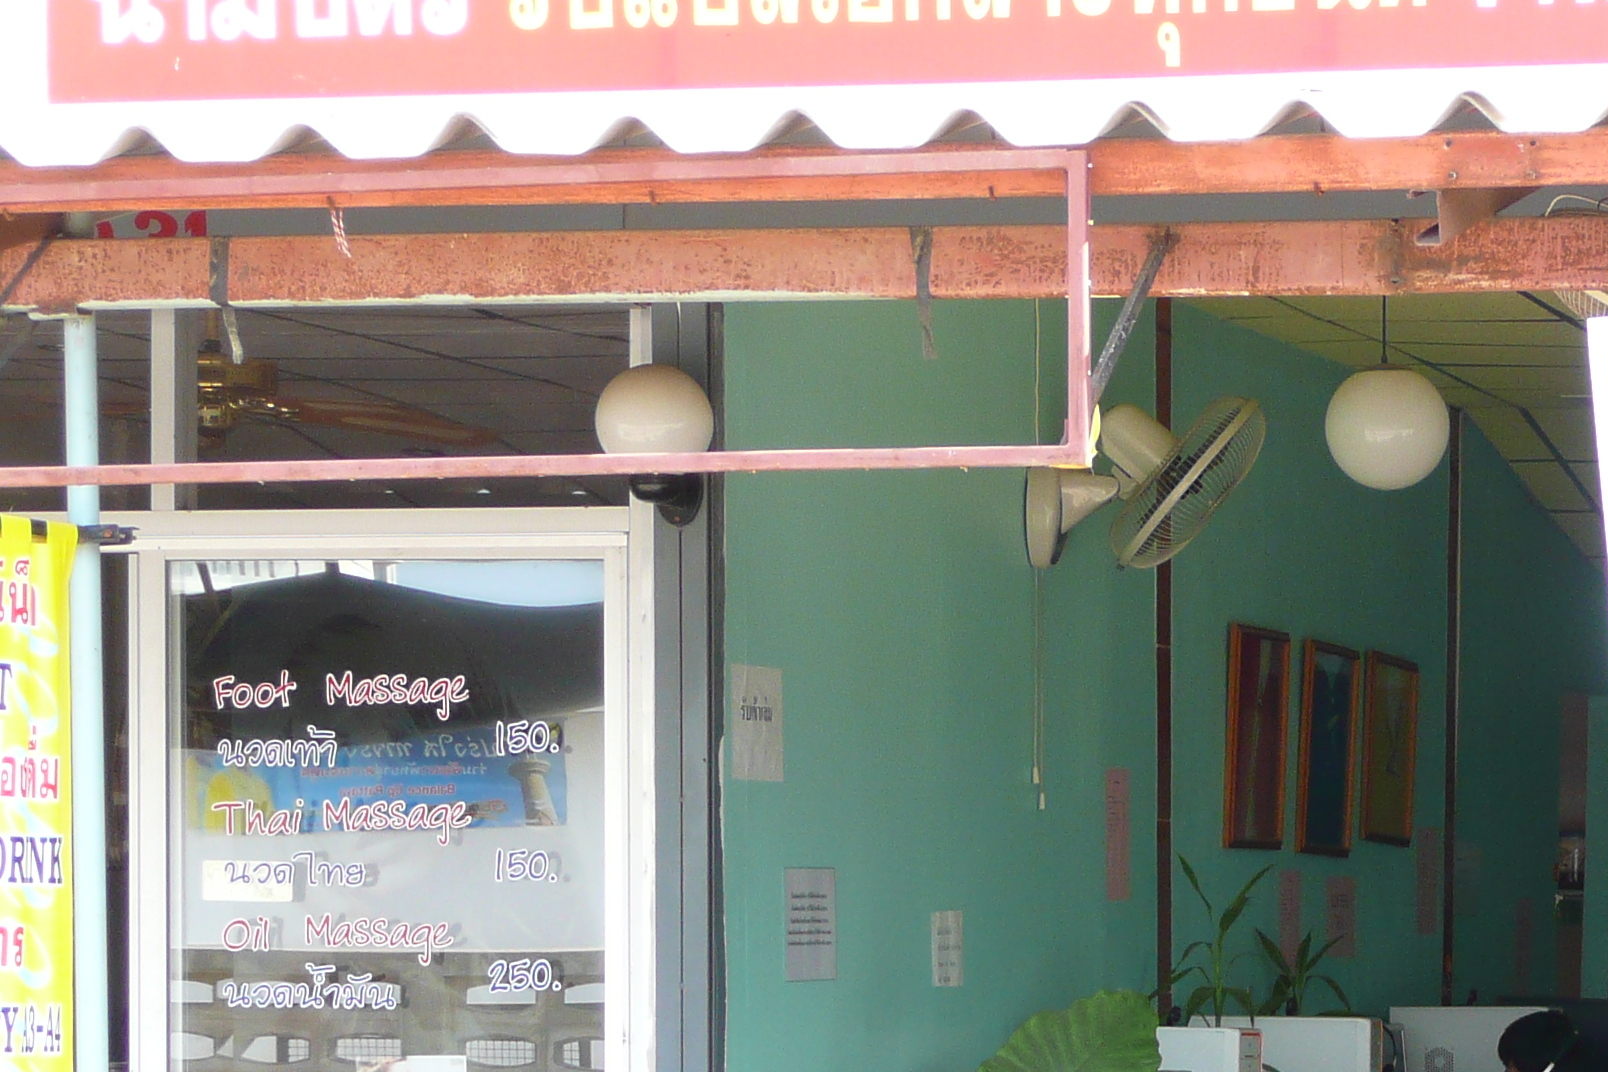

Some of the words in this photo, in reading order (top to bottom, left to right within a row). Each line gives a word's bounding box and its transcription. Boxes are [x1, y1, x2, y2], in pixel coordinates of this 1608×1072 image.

[213, 670, 296, 709] Foot
[326, 671, 469, 720] Massage
[217, 725, 337, 767] นวดเท้า
[212, 799, 304, 836] Thai
[323, 797, 472, 845] Massage
[224, 851, 365, 887] นวดไทย
[222, 916, 271, 952] Oil
[304, 913, 454, 966] Massage
[222, 962, 396, 1010] นวดน้ำมัน
